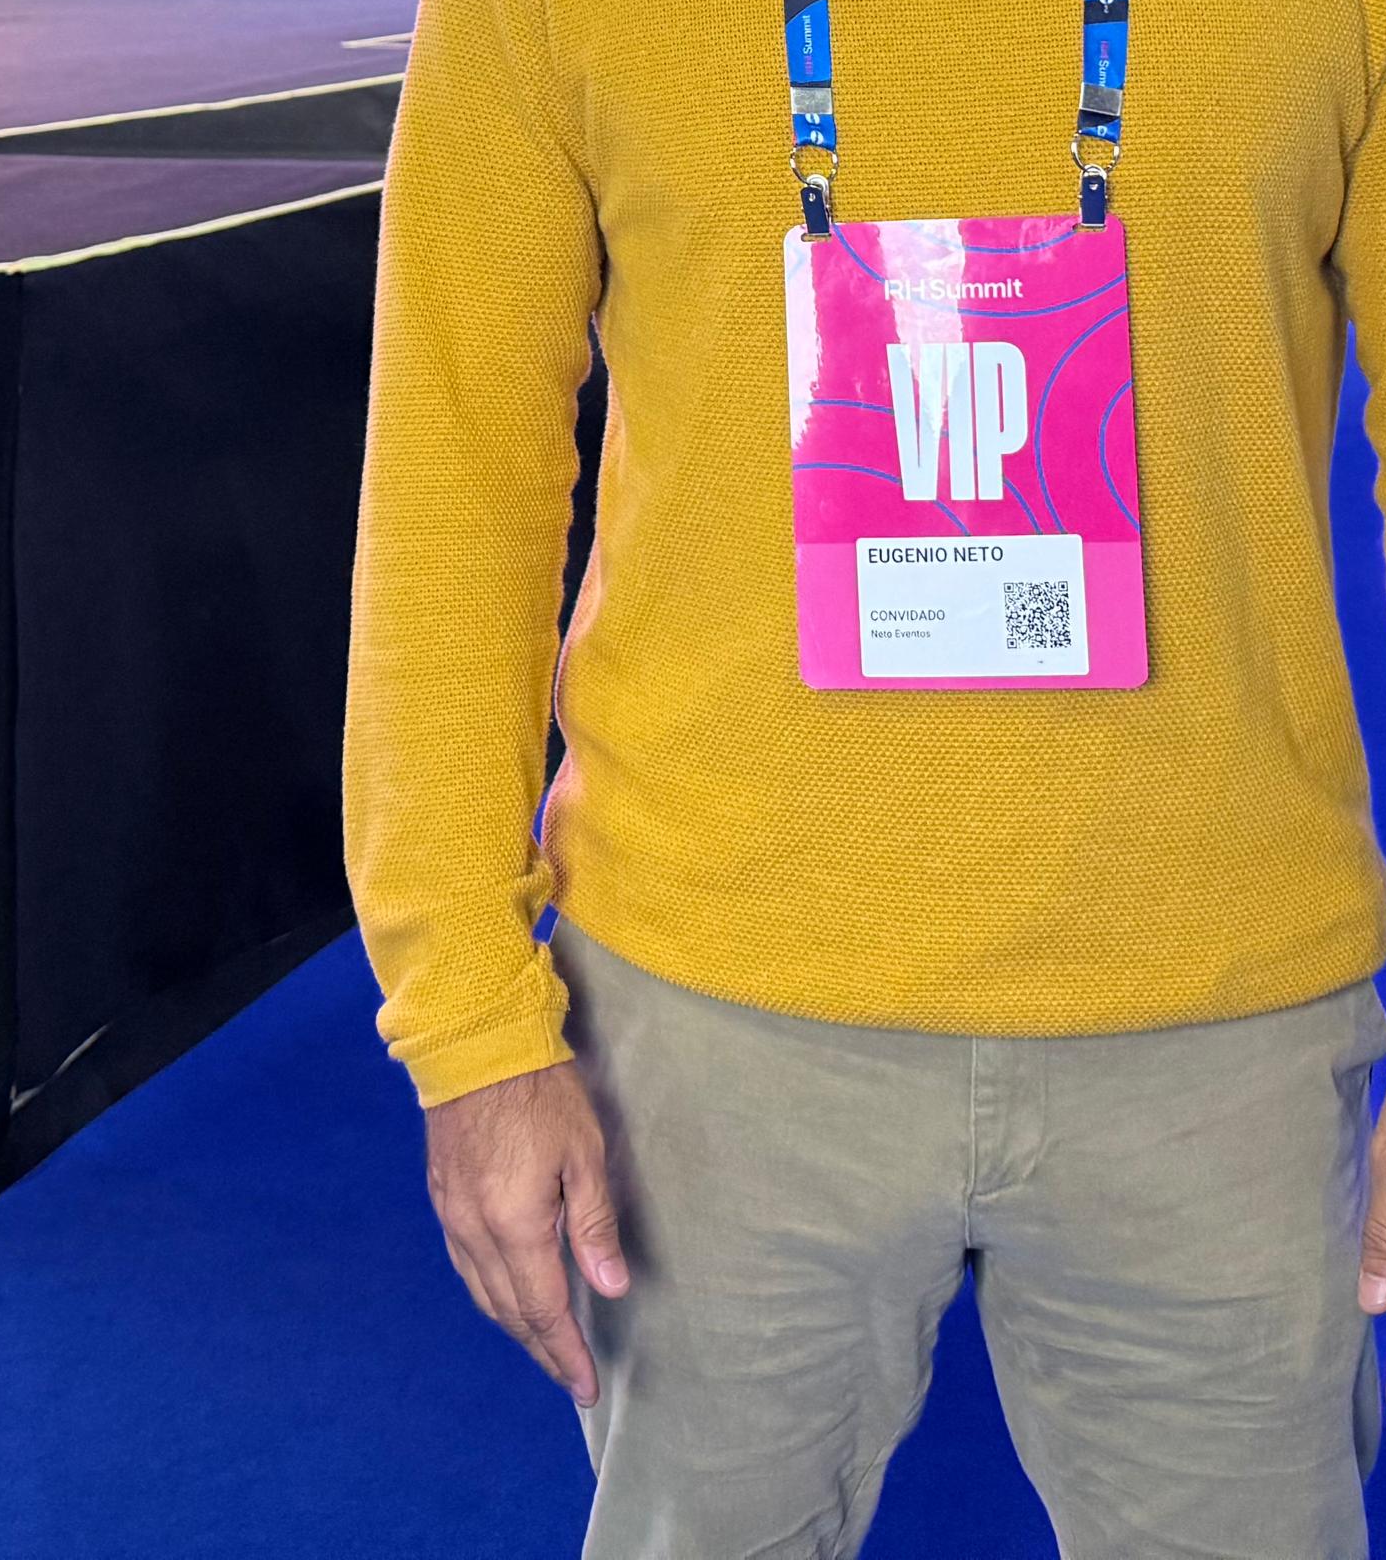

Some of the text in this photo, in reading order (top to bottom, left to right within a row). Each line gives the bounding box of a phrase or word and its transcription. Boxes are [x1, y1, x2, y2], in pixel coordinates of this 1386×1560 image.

[886, 341, 1029, 501] VIP
[868, 546, 1004, 564] EUGENIO NETO
[870, 609, 946, 622] CONVIDADO
[894, 629, 931, 639] Eventos
